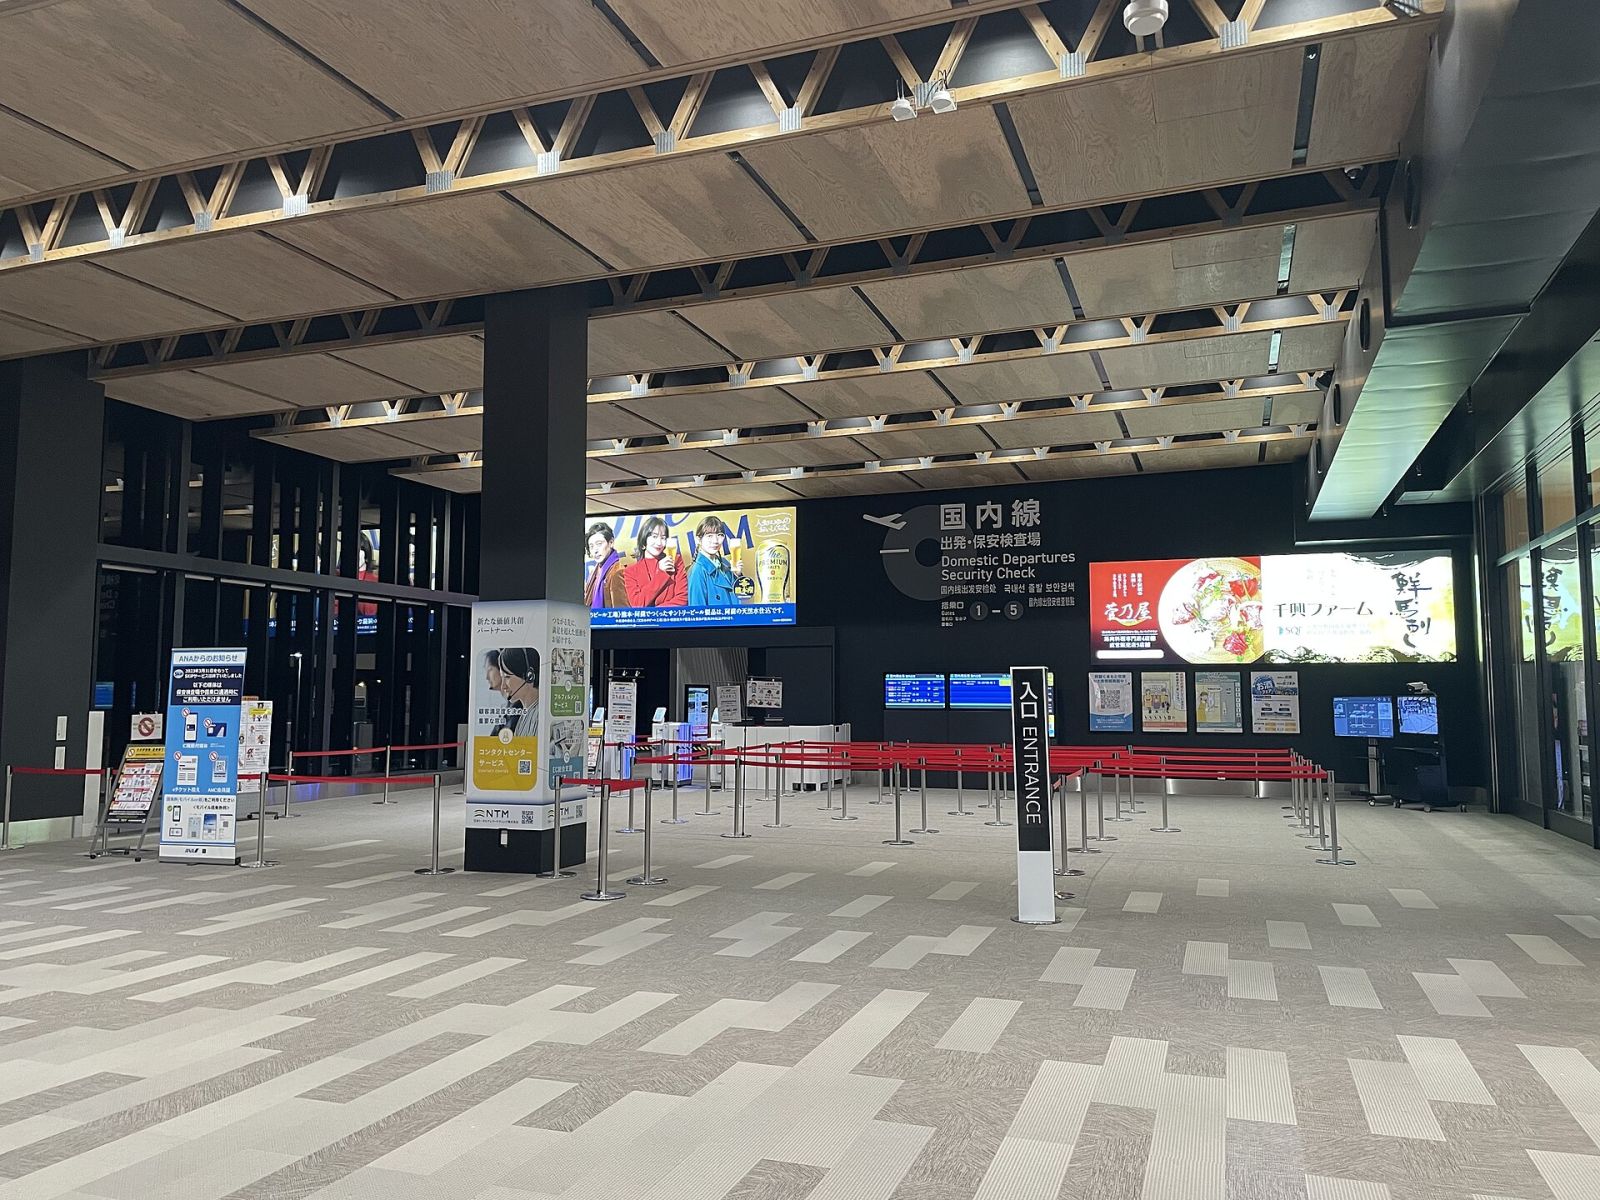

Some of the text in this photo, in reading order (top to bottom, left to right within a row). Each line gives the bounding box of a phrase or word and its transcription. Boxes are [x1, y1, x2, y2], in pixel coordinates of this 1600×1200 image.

[941, 499, 1041, 530] 国内線
[941, 552, 1076, 568] Domestic Departures
[941, 566, 1036, 582] Security Check
[975, 604, 1018, 616] 1 5
[179, 655, 239, 663] ANAからのお知らせ
[1019, 682, 1038, 719] 入口
[479, 749, 533, 757] コンタクトセンター
[1022, 726, 1042, 825] ENTRANCE
[486, 809, 509, 819] NTM
